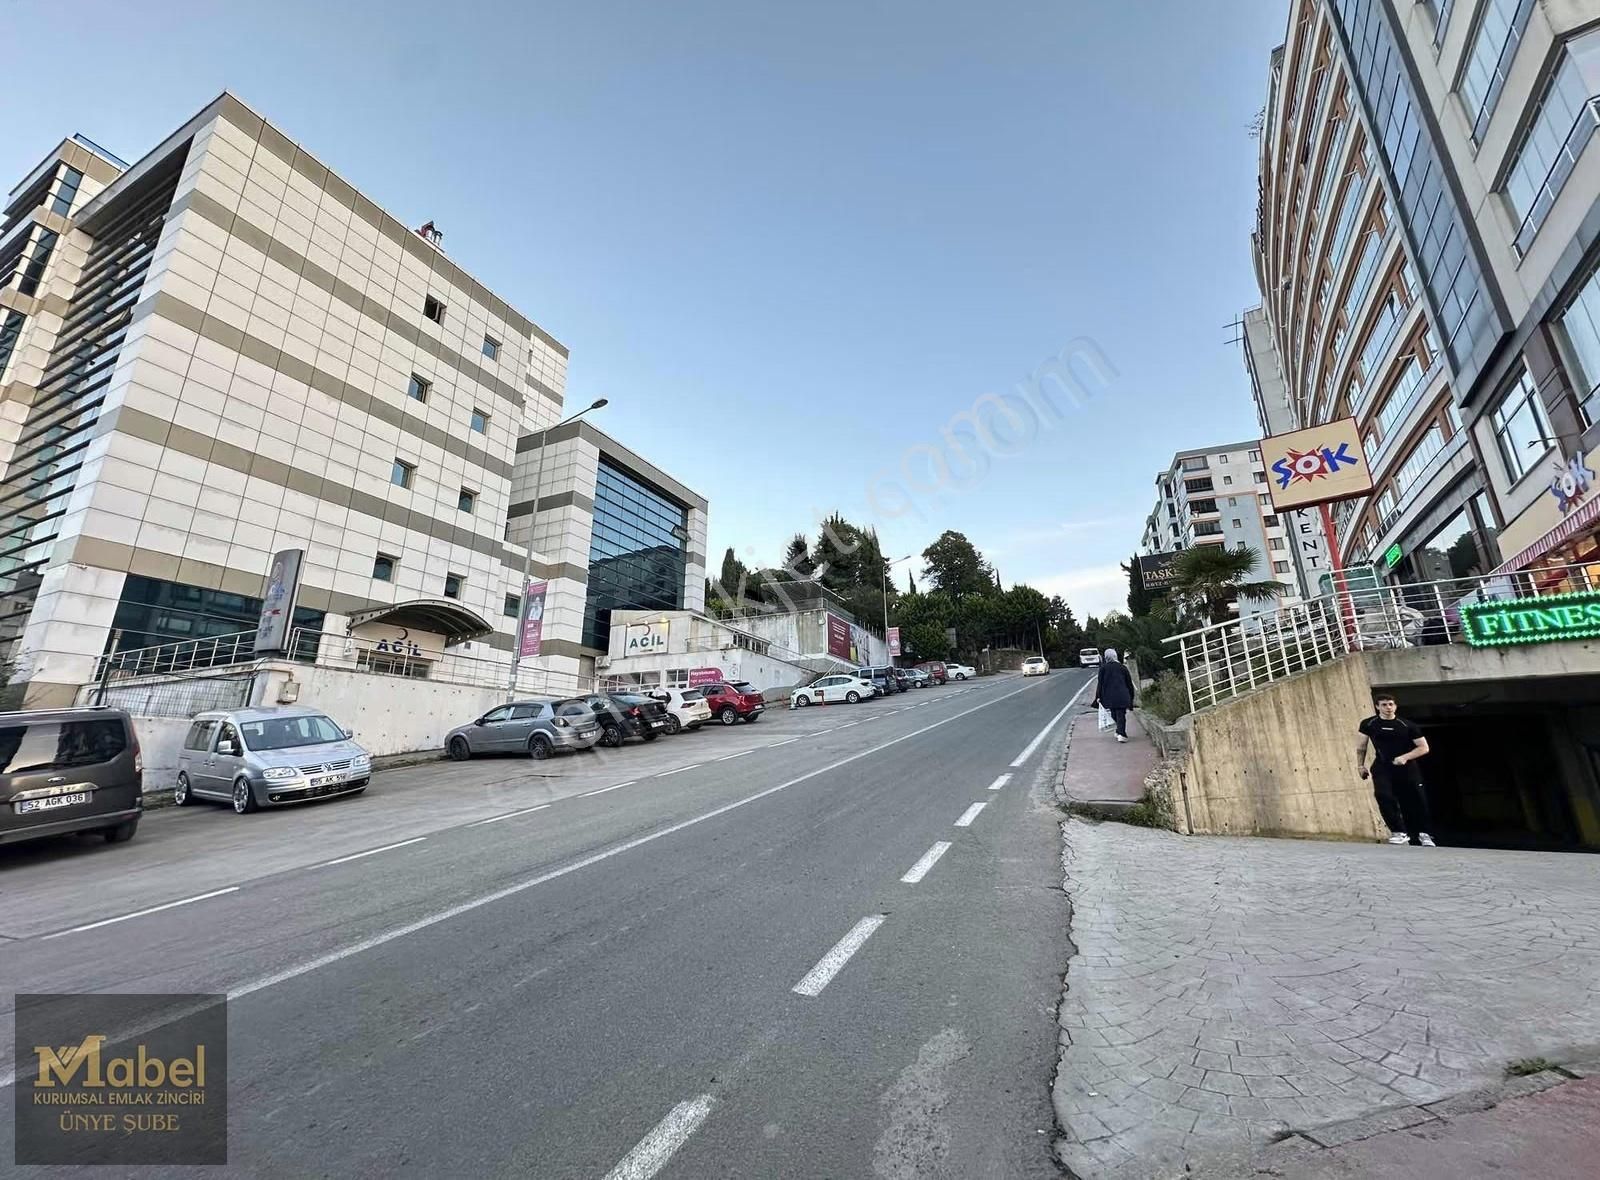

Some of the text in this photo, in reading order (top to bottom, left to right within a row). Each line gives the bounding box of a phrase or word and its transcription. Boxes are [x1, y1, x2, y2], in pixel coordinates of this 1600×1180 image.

[1271, 442, 1358, 490] ŞOK
[376, 638, 421, 656] ACİL
[629, 633, 664, 649] ACİL
[28, 800, 40, 808] 52
[45, 797, 63, 807] AGK
